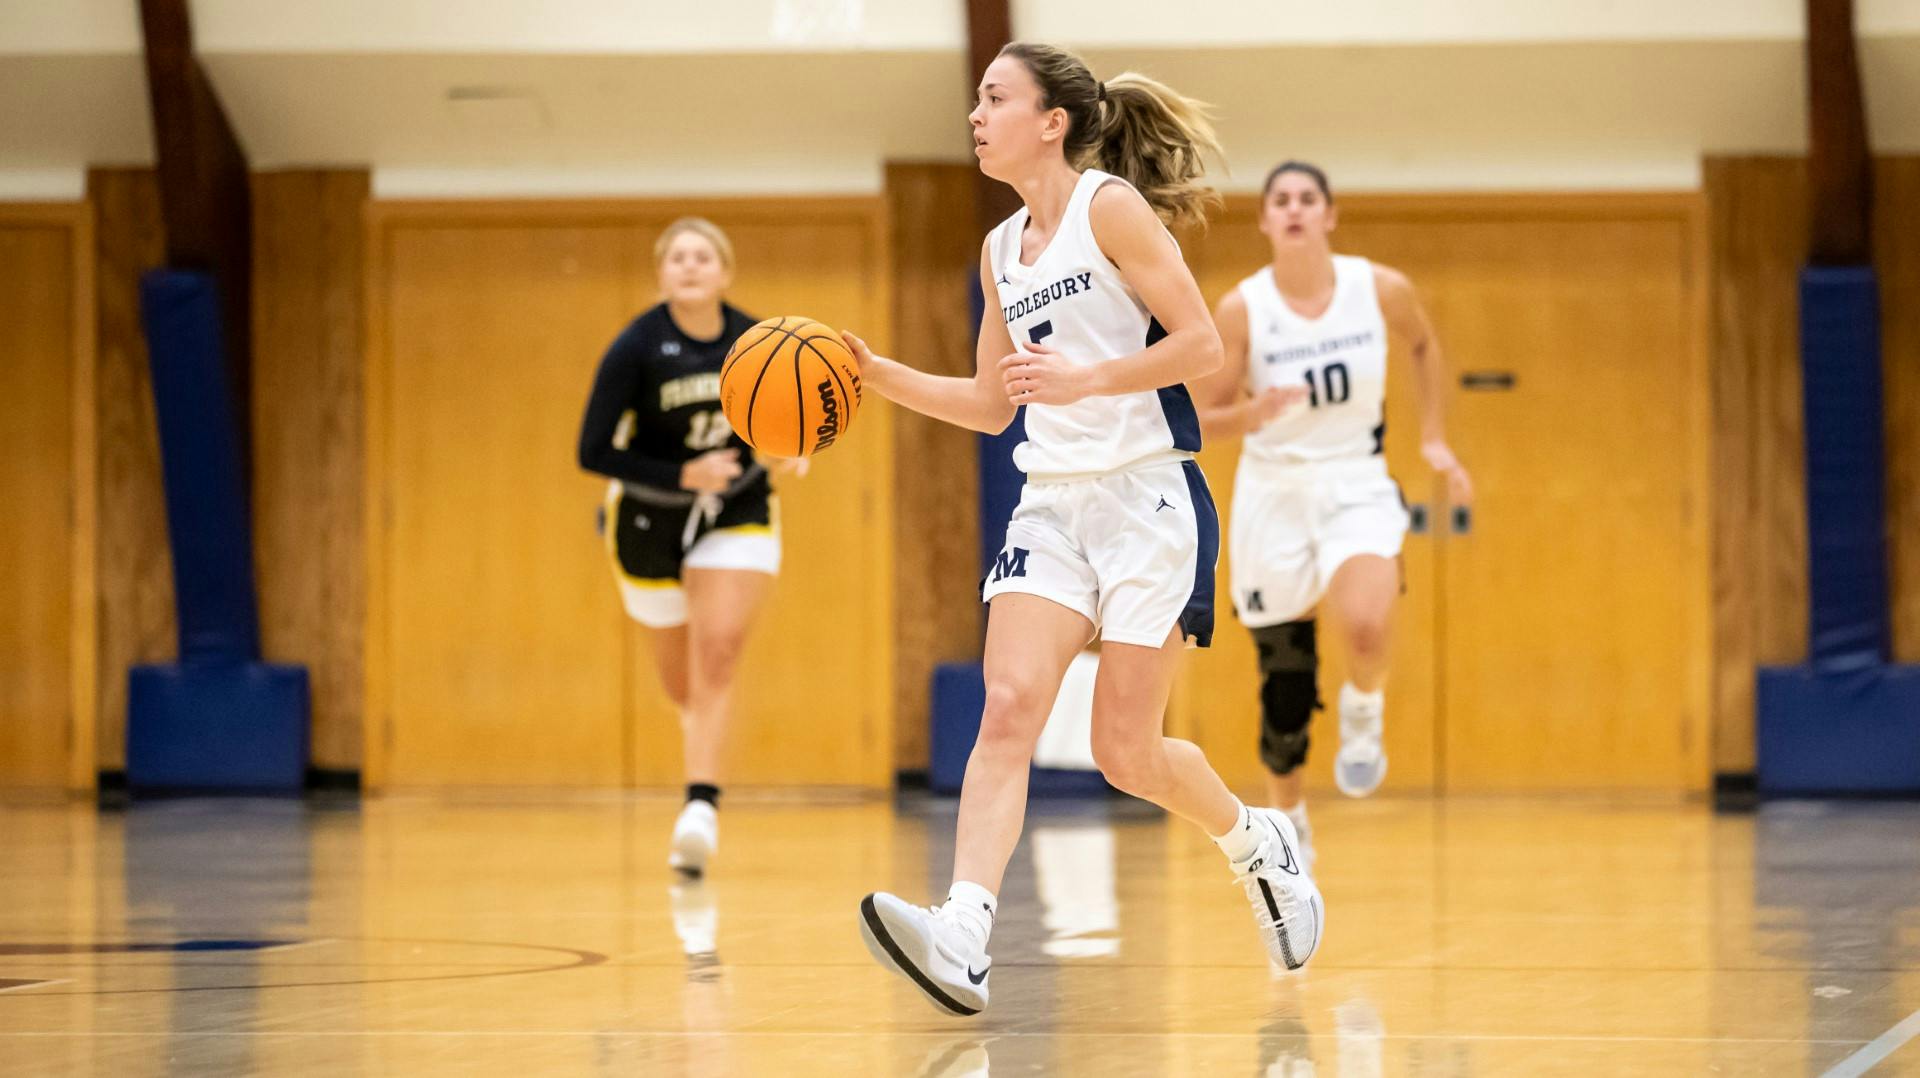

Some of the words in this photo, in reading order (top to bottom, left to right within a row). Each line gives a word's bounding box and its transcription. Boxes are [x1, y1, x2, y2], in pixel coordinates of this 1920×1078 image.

[1001, 272, 1092, 324] IDDLEBURY
[1304, 361, 1350, 409] 10
[811, 376, 838, 455] Wilson
[992, 546, 1030, 583] M
